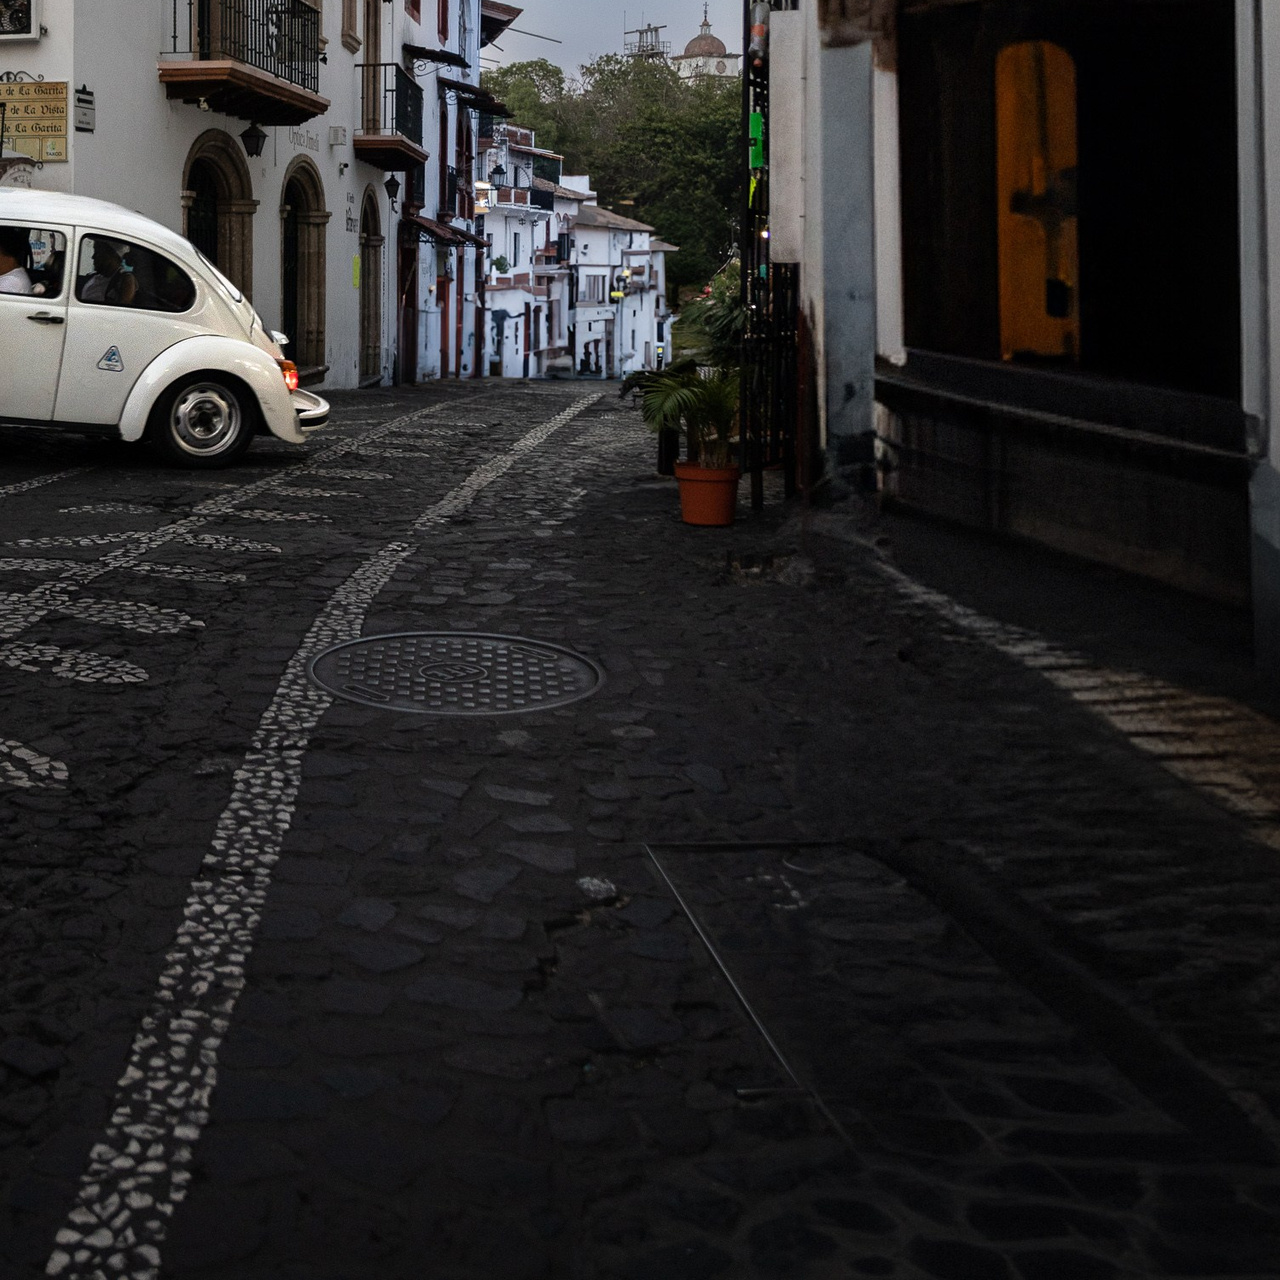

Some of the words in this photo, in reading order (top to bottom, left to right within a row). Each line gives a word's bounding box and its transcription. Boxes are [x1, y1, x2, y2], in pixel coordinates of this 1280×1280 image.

[6, 86, 15, 96] de
[19, 85, 30, 96] La
[34, 85, 64, 96] Garita
[10, 105, 20, 115] de
[24, 105, 36, 115] La
[40, 104, 65, 115] Vista
[15, 123, 27, 133] La
[31, 123, 62, 133] Garita
